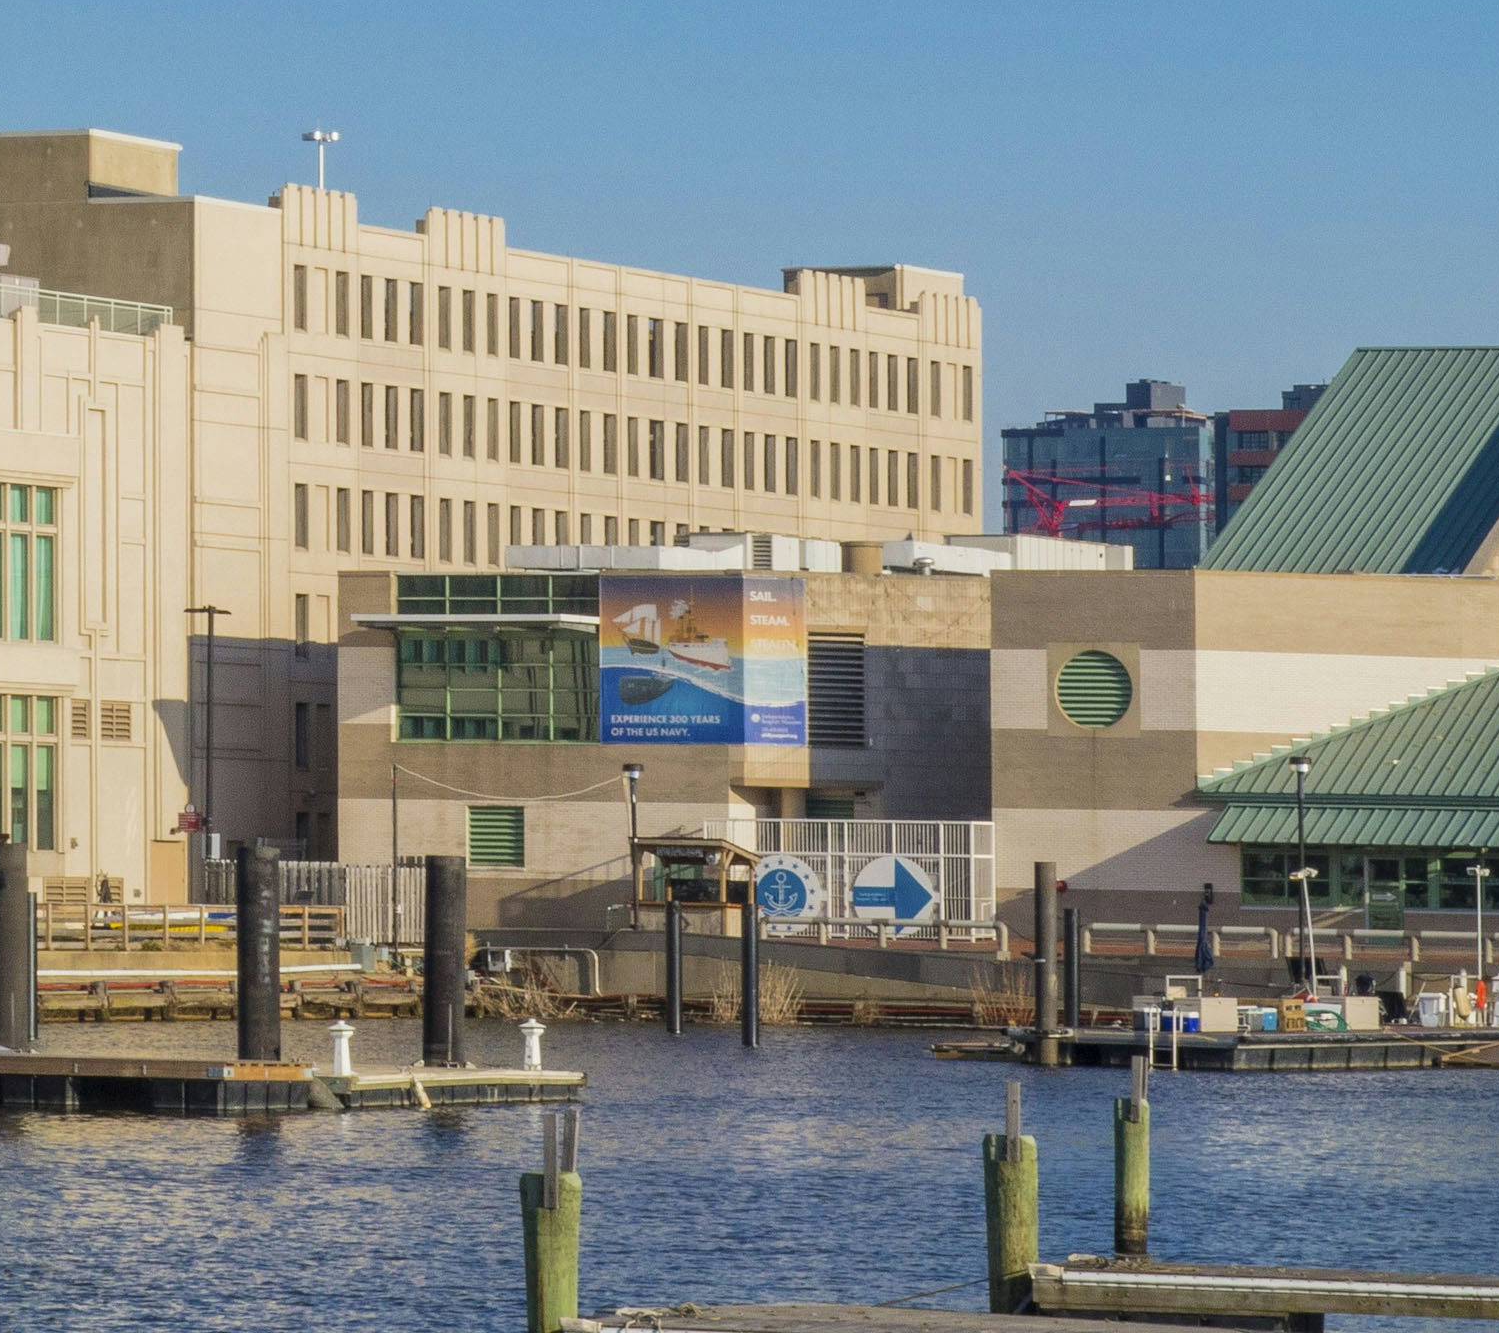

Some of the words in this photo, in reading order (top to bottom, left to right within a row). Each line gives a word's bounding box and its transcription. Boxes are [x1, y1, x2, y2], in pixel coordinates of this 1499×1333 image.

[610, 714, 668, 724] EXPERIENCE
[669, 714, 689, 724] 300
[690, 714, 721, 724] YEARS
[610, 727, 625, 737] OF
[626, 727, 644, 737] THE
[645, 727, 659, 737] US
